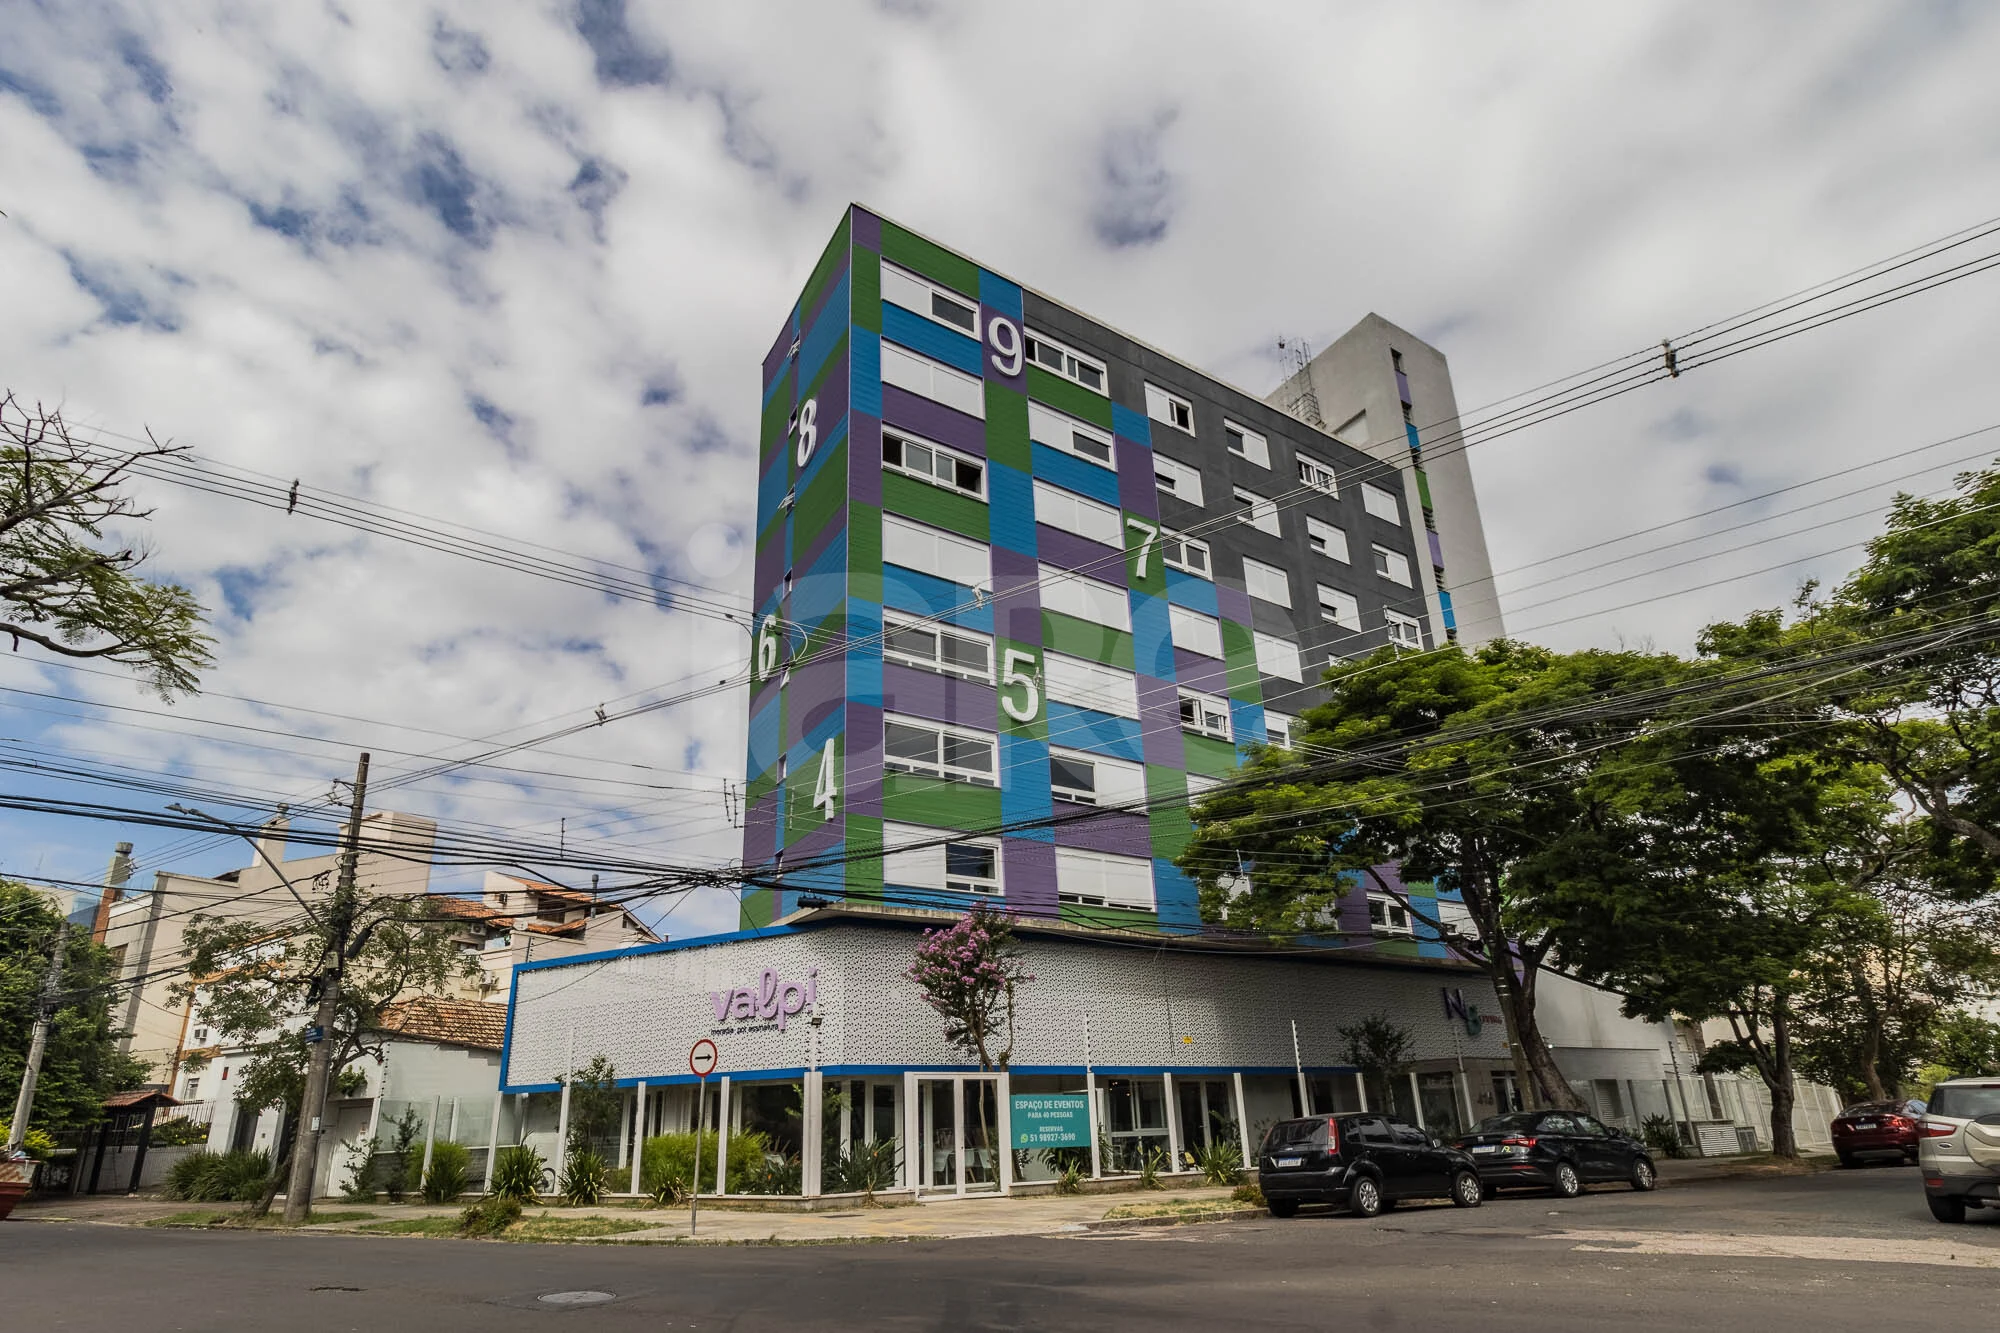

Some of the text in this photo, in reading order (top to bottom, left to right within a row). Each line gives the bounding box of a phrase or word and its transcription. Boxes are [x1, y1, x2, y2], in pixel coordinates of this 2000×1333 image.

[989, 316, 1023, 377] 9
[796, 398, 817, 468] 8
[1127, 518, 1158, 579] 7
[758, 613, 777, 683] 6
[1001, 649, 1038, 723] 5
[813, 737, 838, 820] 4
[711, 967, 817, 1034] valpi
[1015, 1100, 1084, 1111] ESPAÇO DE EVENTOS
[1030, 1134, 1038, 1142] 51
